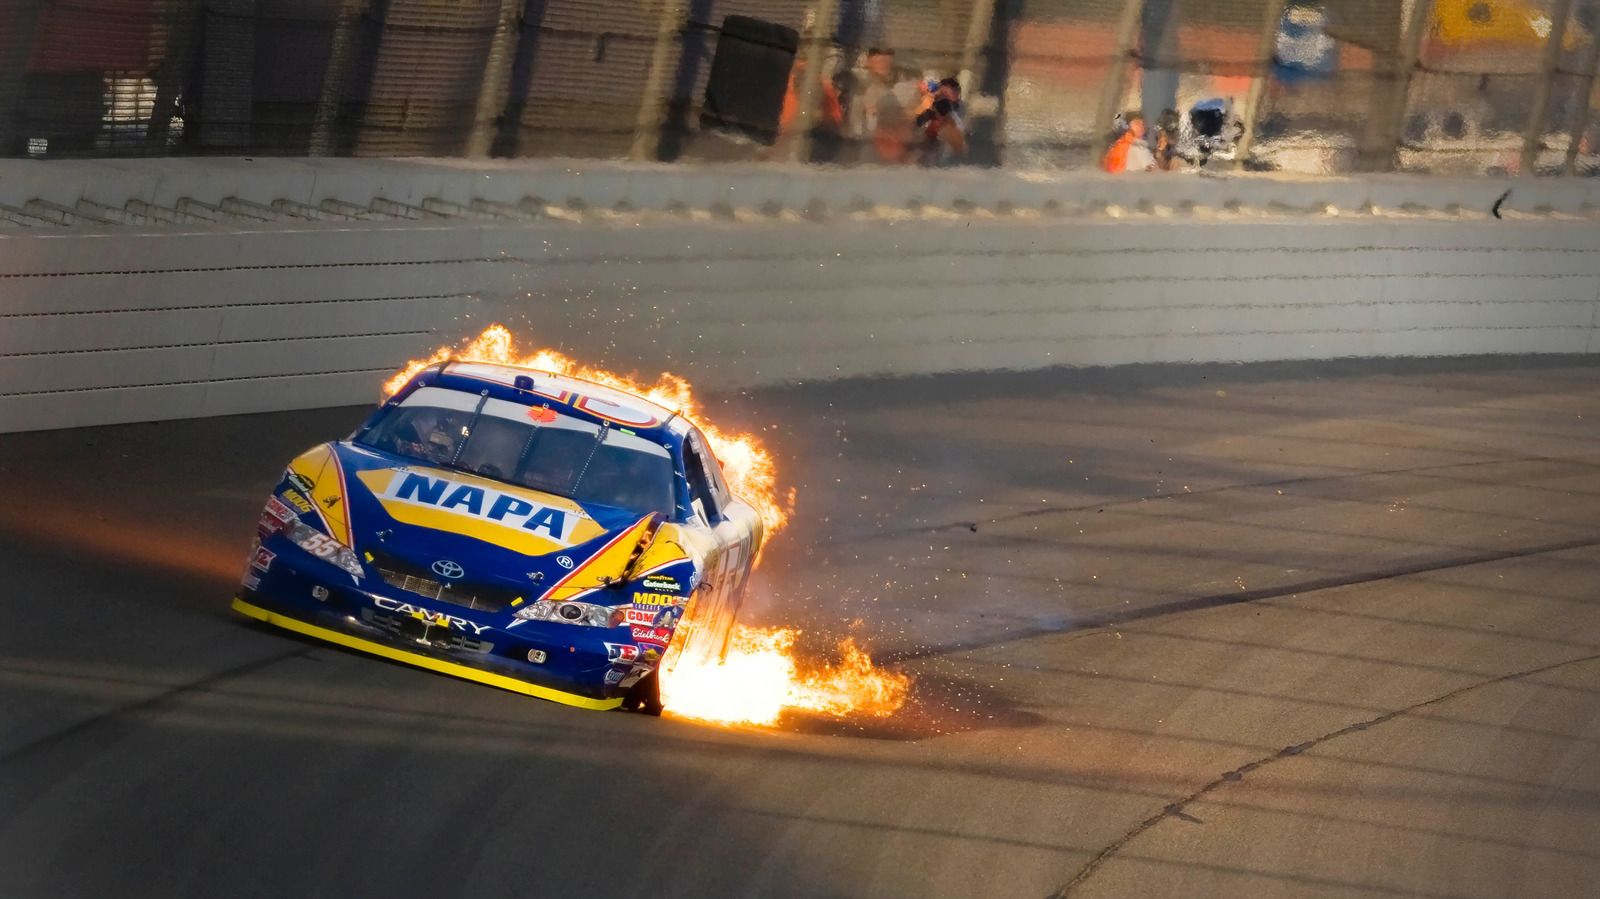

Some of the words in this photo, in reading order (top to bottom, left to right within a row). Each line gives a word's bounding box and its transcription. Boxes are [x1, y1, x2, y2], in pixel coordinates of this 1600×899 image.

[282, 488, 315, 514] MOOG
[396, 473, 567, 540] NAPA
[302, 533, 342, 557] 55
[374, 597, 491, 635] CAMRY
